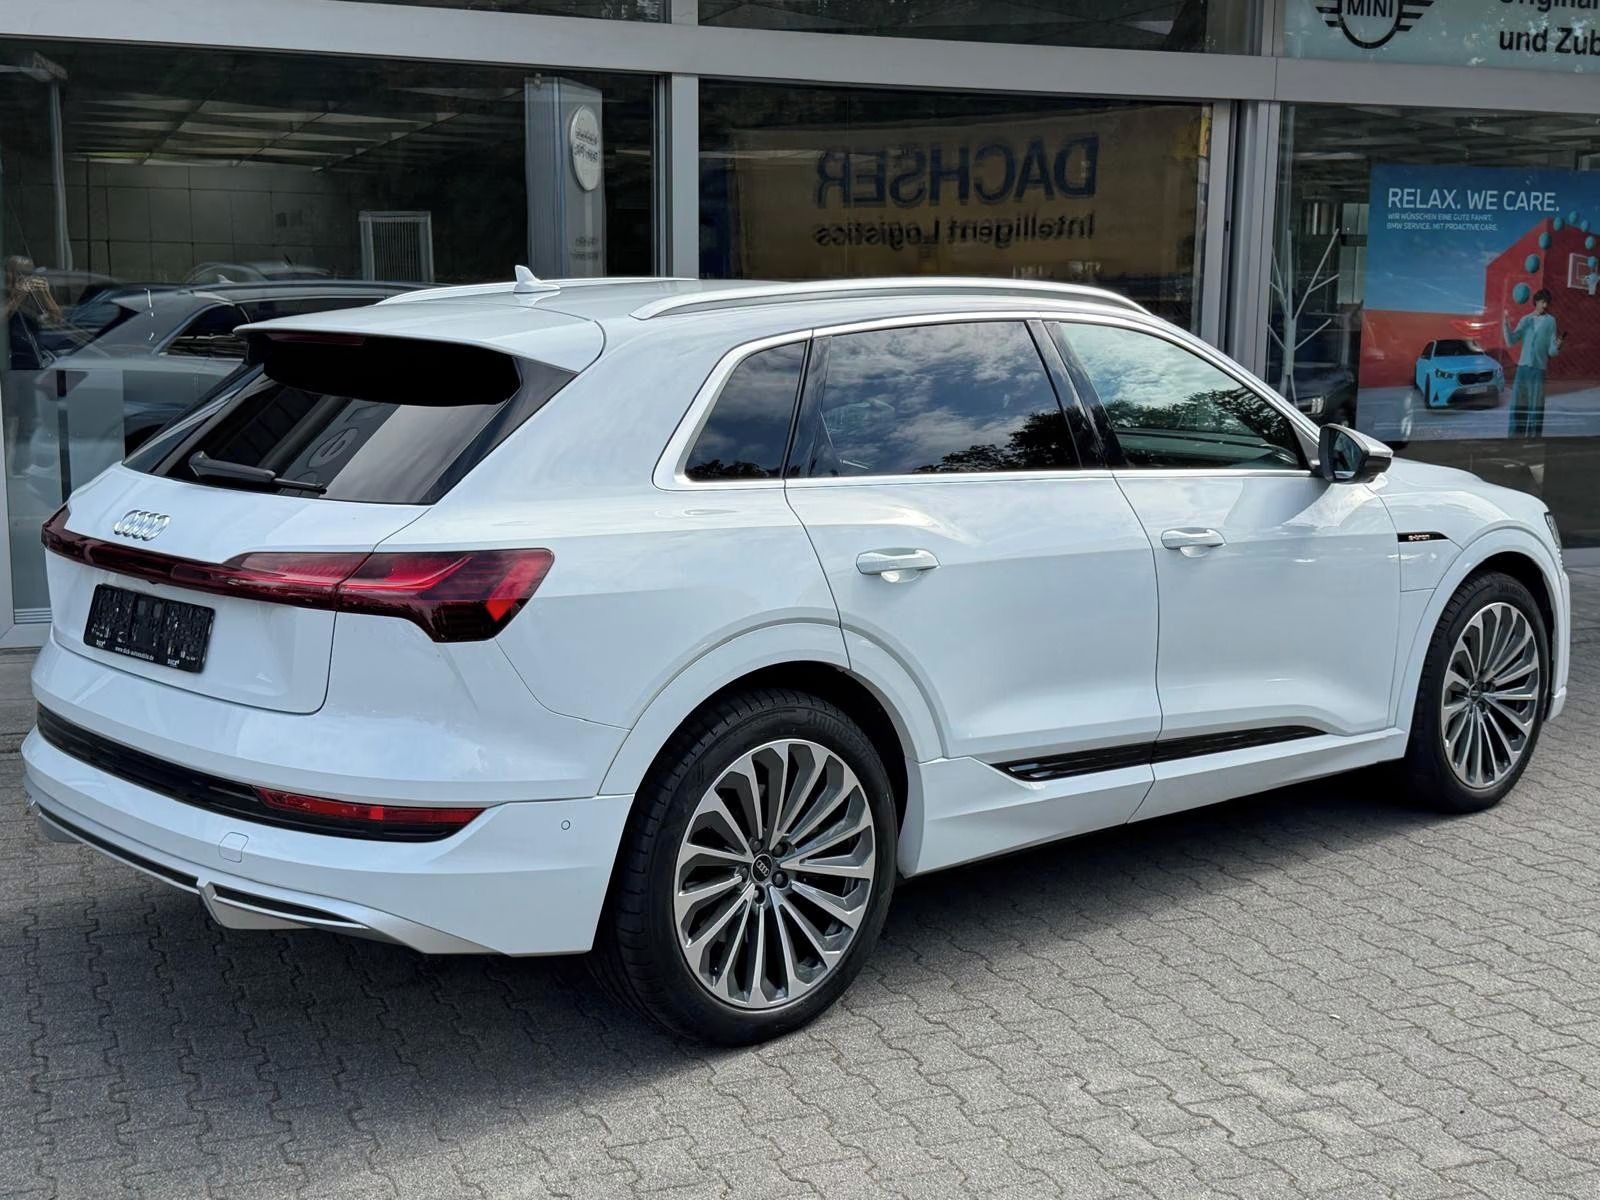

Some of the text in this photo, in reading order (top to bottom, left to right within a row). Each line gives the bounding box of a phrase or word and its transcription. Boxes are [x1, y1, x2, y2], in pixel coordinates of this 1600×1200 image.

[1347, 0, 1393, 18] MINI
[1499, 27, 1548, 52] und
[1388, 187, 1560, 212] RELAX. WE CARE.
